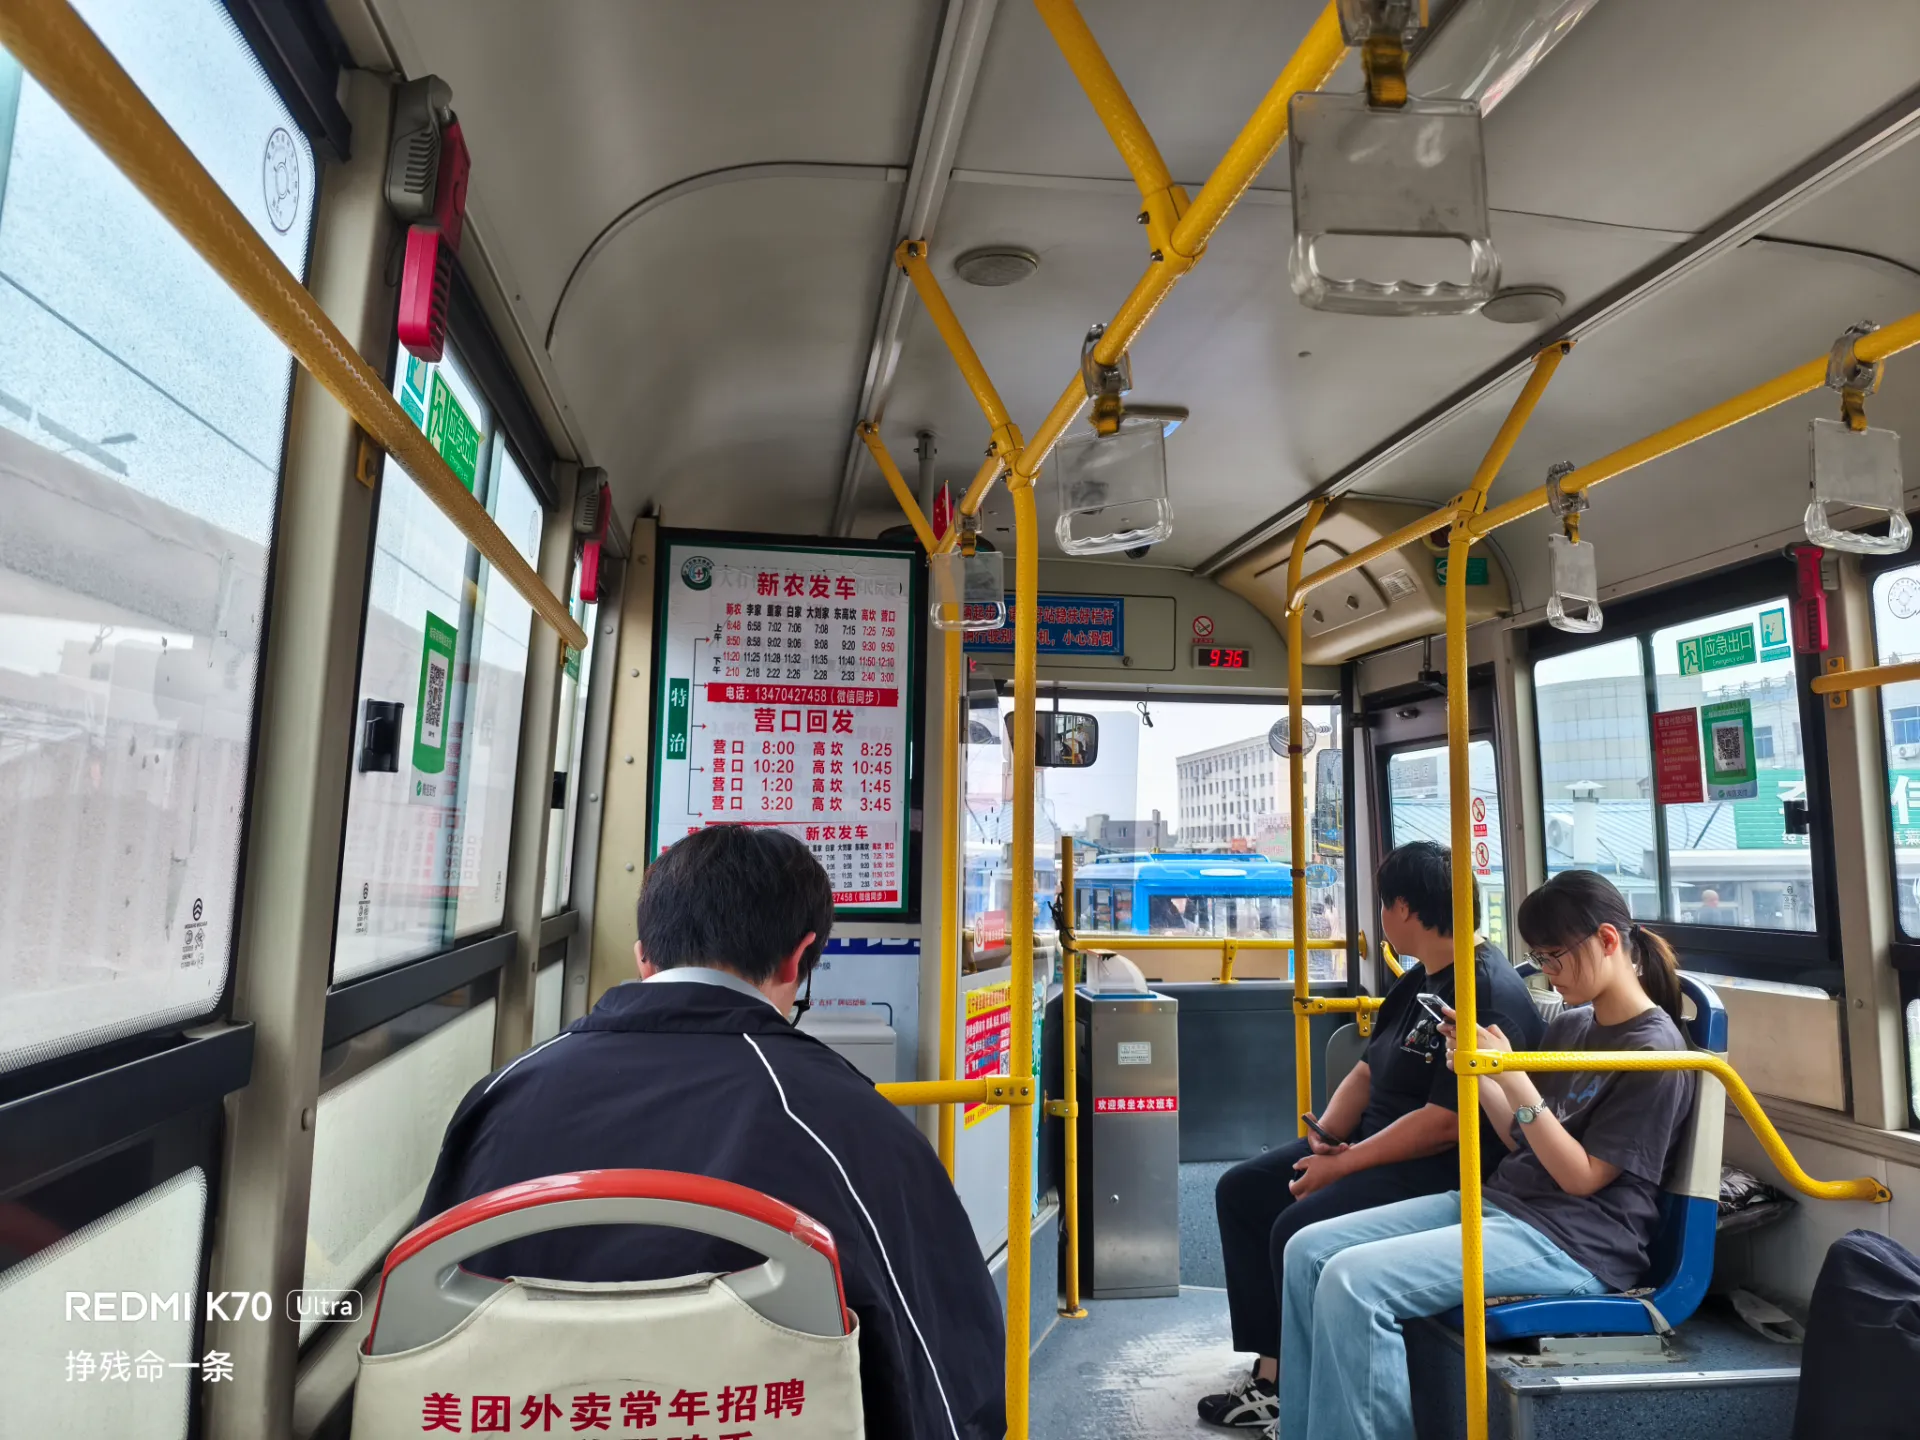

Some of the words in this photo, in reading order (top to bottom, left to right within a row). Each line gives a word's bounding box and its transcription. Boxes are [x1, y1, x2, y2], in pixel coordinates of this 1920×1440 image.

[757, 571, 857, 601] 新农发车
[726, 603, 742, 616] 新农
[746, 604, 762, 617] 李家
[787, 605, 802, 618] 白家
[806, 606, 830, 620] 大刘家
[834, 607, 857, 621] 东高坎
[861, 609, 877, 622] 高坎
[881, 609, 896, 623] 营口
[713, 624, 722, 642] 上午
[727, 620, 741, 631] 6:48
[747, 621, 762, 632] 6:58
[768, 622, 782, 632] 7:02
[788, 622, 802, 633] 7:06
[815, 624, 829, 634] 7:08
[842, 625, 856, 636] 7:15
[862, 626, 876, 637] 7:25
[881, 627, 895, 637] 7:50
[726, 635, 741, 646] 8:50
[746, 636, 761, 647] 8:58
[767, 637, 781, 648] 9:02
[787, 638, 802, 649] 9:06
[814, 639, 829, 650] 9:08
[841, 640, 856, 651] 9:20
[862, 641, 876, 652] 9:30
[881, 642, 895, 652] 9:50
[1704, 630, 1753, 659] 应急出口
[713, 656, 722, 675] 下午
[723, 651, 740, 662] 11:20
[743, 652, 761, 662] 11:25
[764, 652, 781, 663] 11:28
[784, 653, 801, 664] 11:32
[811, 654, 828, 665] 11:35
[838, 655, 856, 666] 11:40
[859, 656, 876, 667] 11:50
[878, 657, 895, 667] 12:10
[725, 666, 740, 677] 2:10
[746, 667, 760, 678] 2:18
[766, 668, 781, 678] 2:22
[786, 669, 801, 679] 2:26
[813, 670, 828, 681] 2:28
[841, 671, 856, 681] 2:33
[861, 672, 876, 682] 2:40
[880, 672, 895, 683] 3:00
[754, 708, 854, 734] 营口回发
[762, 740, 795, 755] 8:00
[860, 742, 892, 757] 8:25
[754, 759, 794, 774] 10:20
[852, 760, 892, 775] 10:45
[761, 778, 793, 792] 1:20
[860, 779, 892, 793] 1:45
[761, 796, 793, 811] 3:20
[860, 797, 892, 812] 3:45
[805, 825, 868, 841] 新农发车
[1098, 1097, 1174, 1111] 欢迎乘坐本次班车
[421, 1378, 806, 1433] 美团外卖常年招聘
